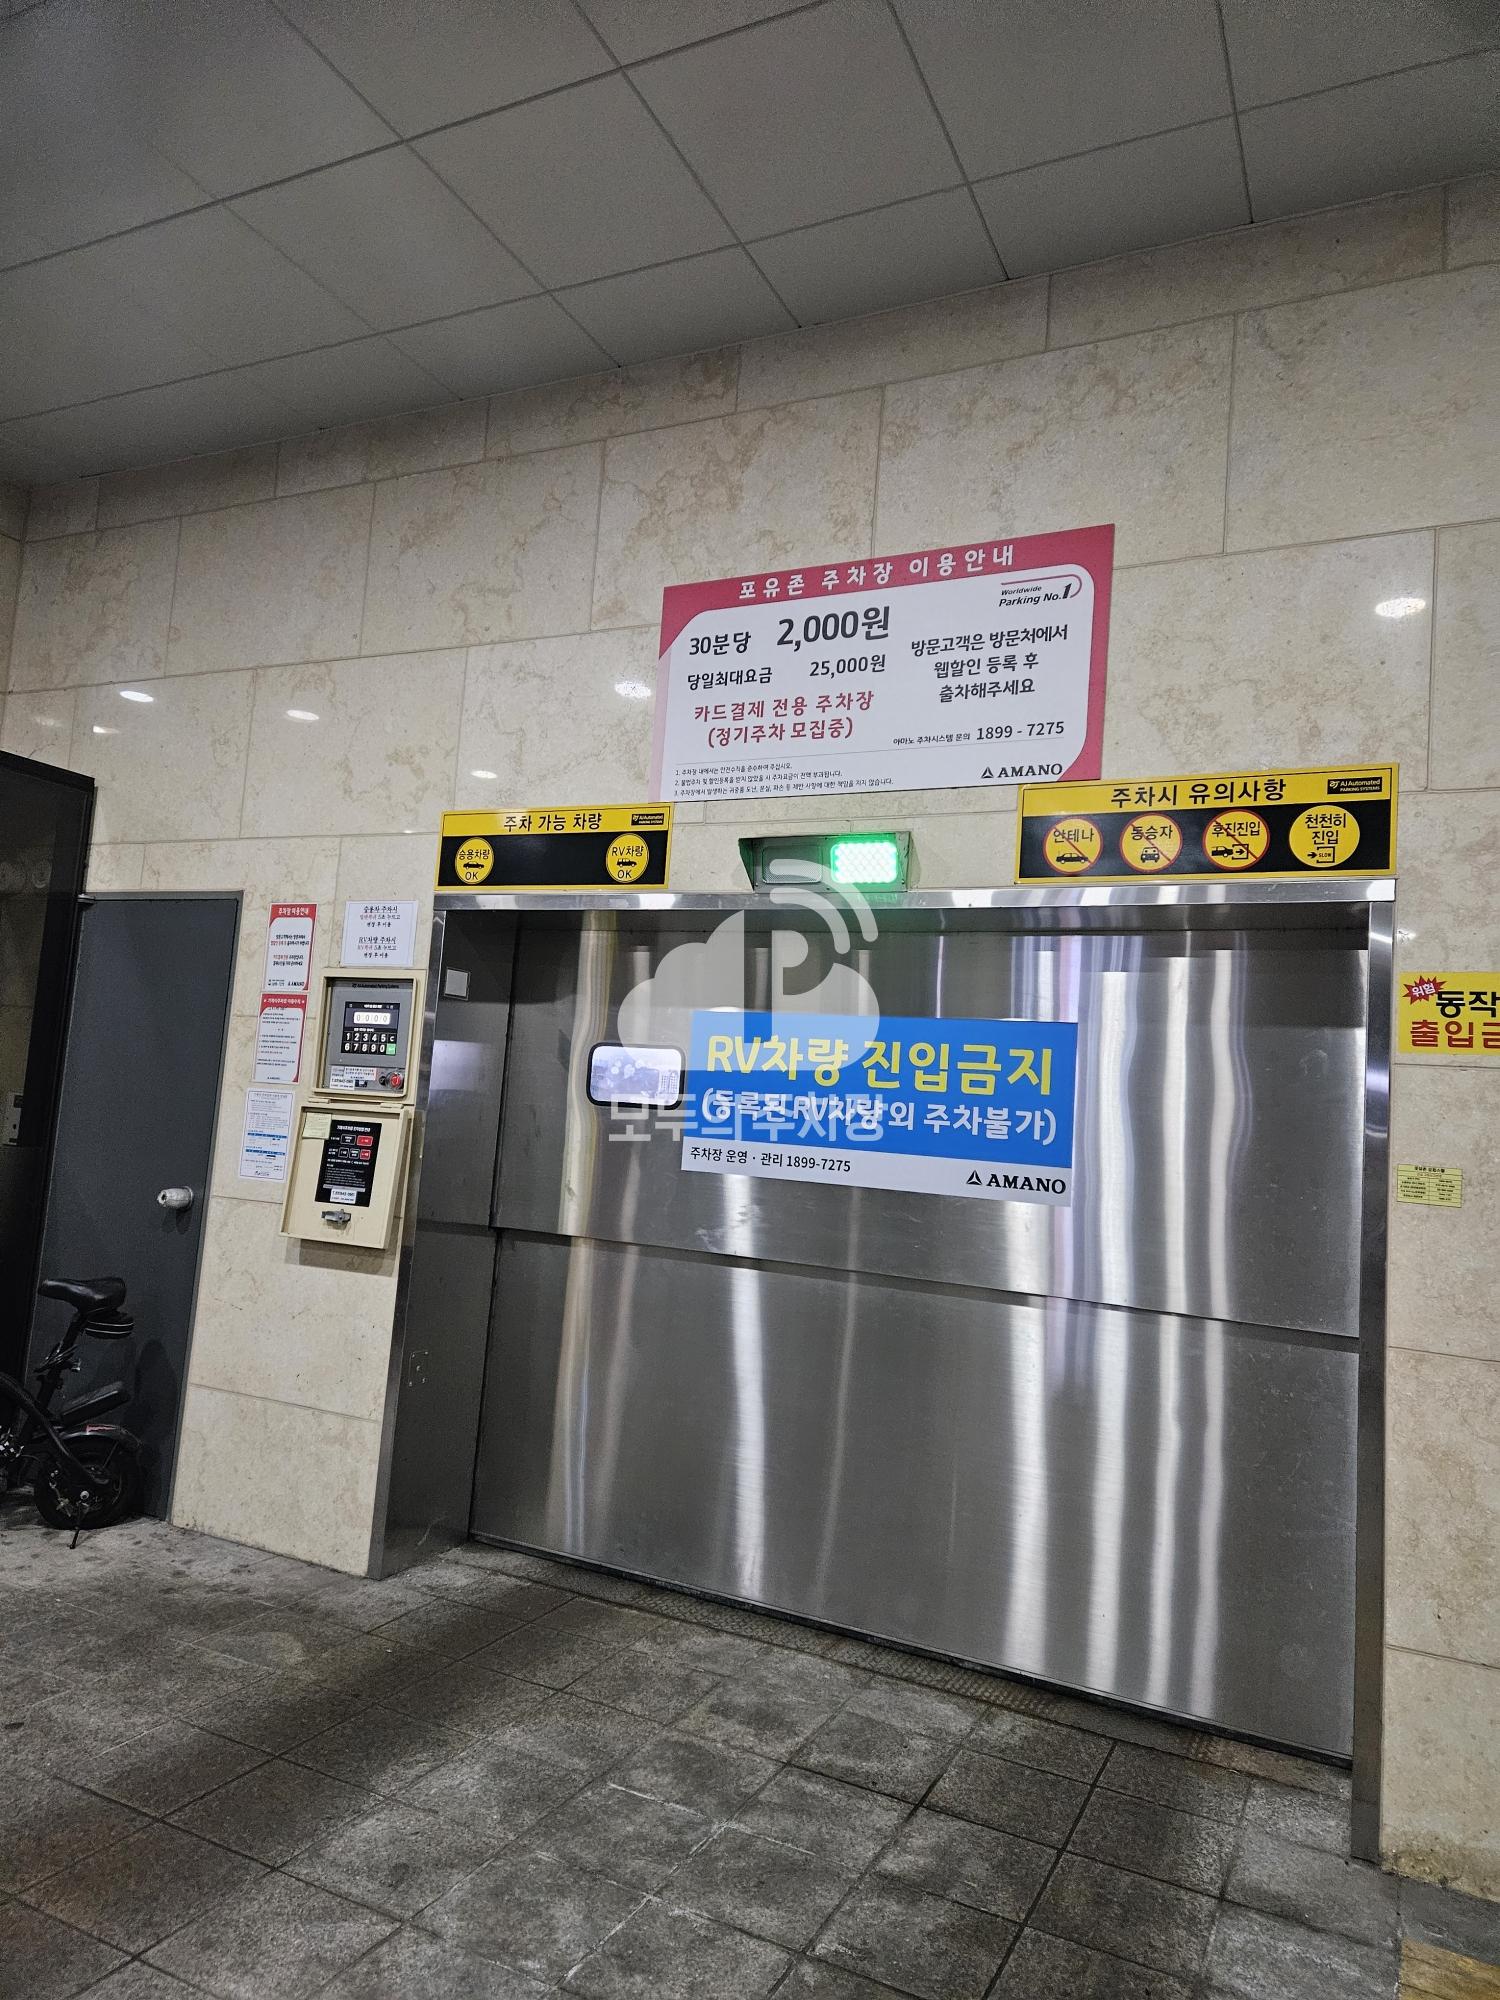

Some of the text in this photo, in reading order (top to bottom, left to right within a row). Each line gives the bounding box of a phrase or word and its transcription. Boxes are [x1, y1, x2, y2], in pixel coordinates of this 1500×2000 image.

[739, 544, 1014, 599] 포유존 주차장 이용안내
[1001, 586, 1042, 595] Worldwide
[999, 596, 1040, 607] Parking
[689, 606, 890, 656] 30분당 2,000원
[911, 624, 1068, 657] 방문고객은 방문처에서
[687, 655, 886, 692] 당일최대요금 25,000원
[934, 652, 1038, 679] 웹할인 등록 후
[939, 679, 1035, 703] 출차해주세요
[694, 690, 874, 722] 카드결제 전용 주차장
[708, 716, 853, 749] (정기주차 모집중)
[917, 734, 953, 744] 주차시스템
[956, 733, 970, 741] 문의
[976, 725, 1012, 740] 1899
[1027, 721, 1064, 736] 7275
[998, 763, 1063, 778] AMANO
[1111, 779, 1286, 808] 주차시 유의사항
[504, 813, 602, 832] 주차 가능 차량
[1211, 821, 1261, 838] 후진진입
[1304, 813, 1347, 830] 천천히
[1053, 828, 1094, 843] 안테나
[1131, 824, 1173, 841] 동승자
[1312, 829, 1339, 845] 진입
[458, 849, 490, 860] 승용차량
[612, 846, 644, 857] RV차량
[465, 872, 478, 880] OK
[618, 870, 632, 879] OK
[1412, 983, 1436, 997] 위험
[1436, 991, 1500, 1018] 동작
[707, 1035, 1052, 1096] RV차량 진입금지
[702, 1087, 1057, 1146] (등록된 RV차량 외 주차불가)
[691, 1147, 722, 1161] 주차장
[726, 1150, 748, 1163] 운영
[761, 1152, 783, 1167] 관리
[787, 1156, 851, 1172] 1899-7275
[986, 1174, 1066, 1194] AMANO
